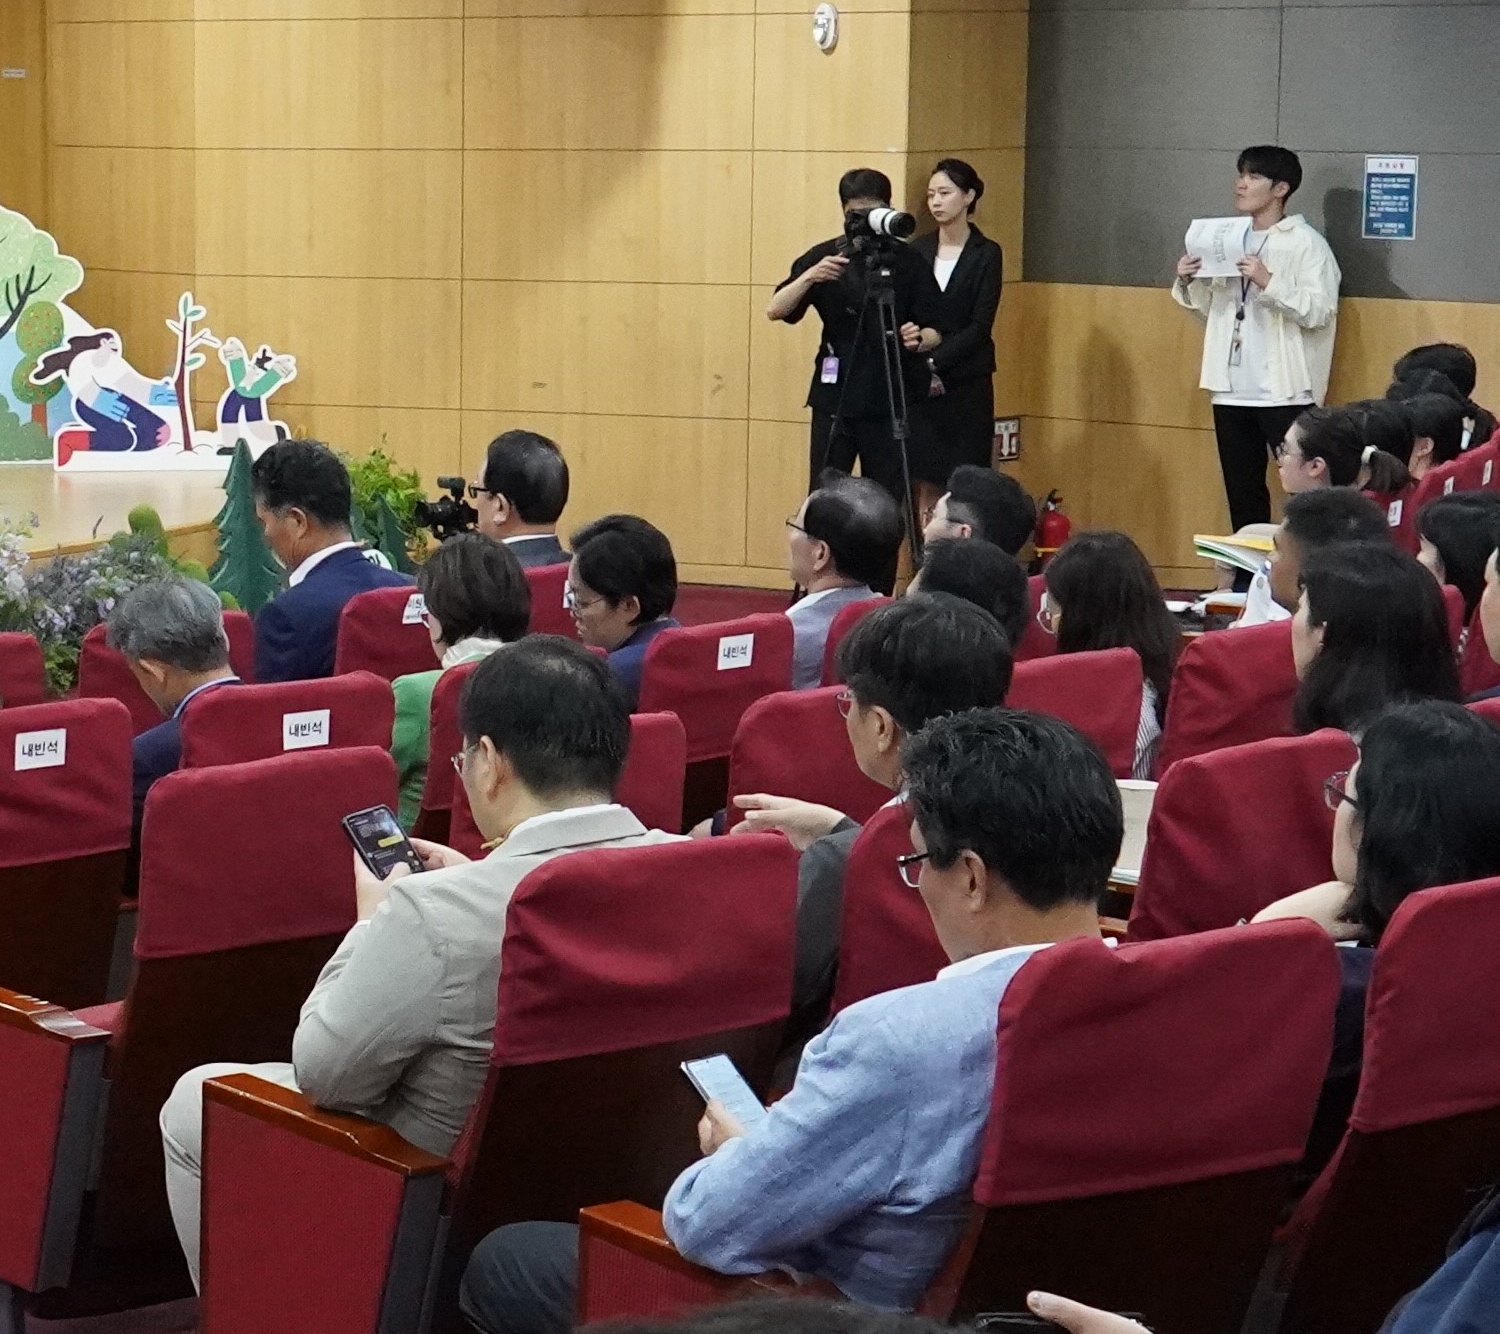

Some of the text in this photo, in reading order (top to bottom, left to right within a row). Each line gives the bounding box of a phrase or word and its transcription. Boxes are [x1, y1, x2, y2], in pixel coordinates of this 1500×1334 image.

[723, 644, 748, 659] 내빈석
[288, 720, 322, 737] 내빈석
[21, 740, 58, 757] 내빈석
